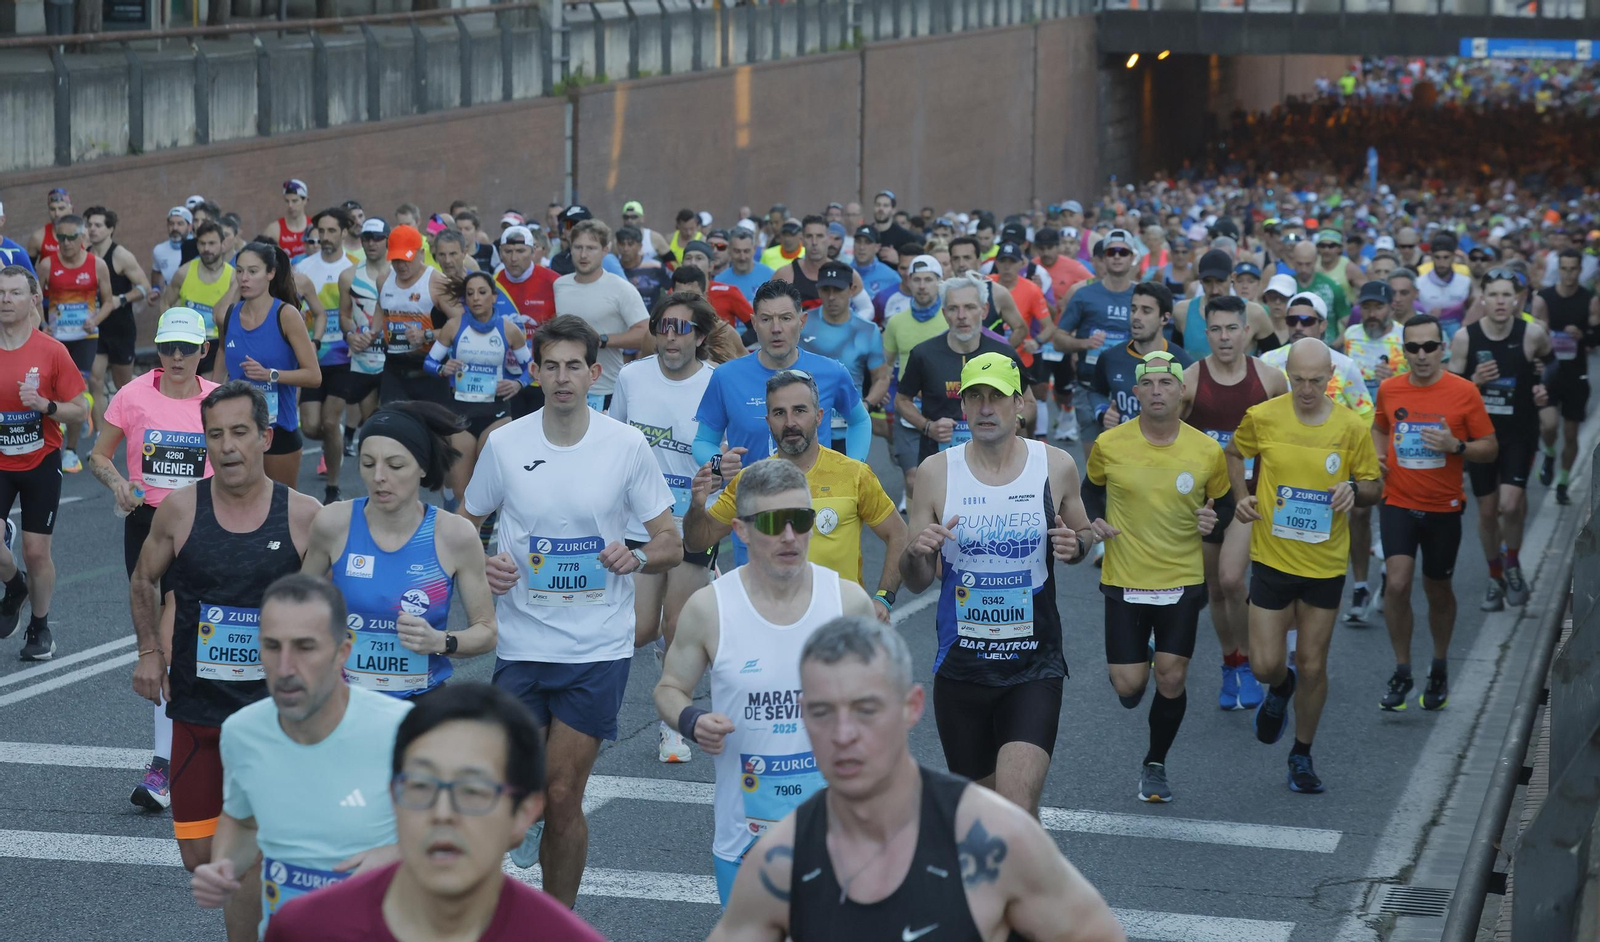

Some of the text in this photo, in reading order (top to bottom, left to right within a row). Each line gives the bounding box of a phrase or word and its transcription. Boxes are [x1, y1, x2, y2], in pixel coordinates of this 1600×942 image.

[1107, 305, 1128, 317] FAR
[470, 364, 494, 373] ZURICH
[467, 384, 484, 393] TRIX
[7, 412, 35, 421] ZURICH
[166, 434, 200, 444] ZURICH
[165, 451, 184, 460] 4260
[152, 461, 195, 475] KIENER
[665, 478, 685, 486] RICH
[1295, 491, 1328, 502] ZURICH
[957, 512, 1041, 529] RUNNERS
[1286, 515, 1317, 530] 10973
[976, 518, 1041, 546] Palmera
[556, 541, 597, 552] ZURICH
[557, 563, 580, 572] 7778
[548, 575, 587, 589] JULIO
[980, 576, 1023, 586] ZURICH
[982, 596, 1005, 605] 6342
[964, 606, 1025, 623] JOAQUÍN
[369, 619, 395, 630] ZUR
[228, 634, 252, 643] 6767
[370, 641, 394, 651] 7311
[959, 638, 1039, 651] BAR PATRÓN
[976, 652, 1020, 660] HUELVA
[357, 654, 409, 672] LAURE
[748, 690, 803, 707] MARAT
[744, 706, 761, 721] DE
[772, 723, 797, 734] 2025
[774, 784, 802, 796] 7906
